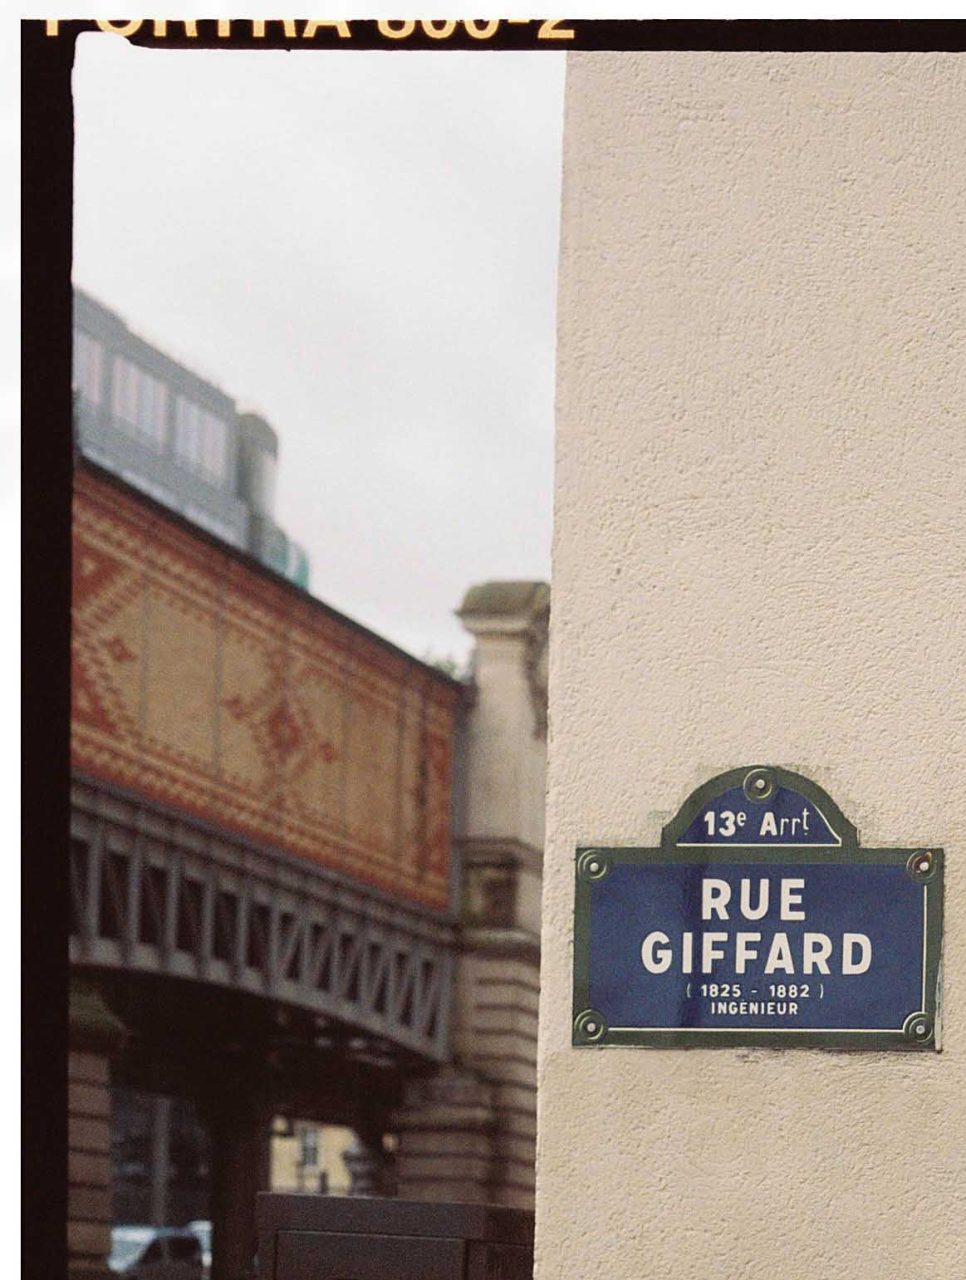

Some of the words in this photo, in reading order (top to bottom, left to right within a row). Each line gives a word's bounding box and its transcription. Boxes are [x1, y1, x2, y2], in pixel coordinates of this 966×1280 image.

[704, 810, 747, 837] 13e
[702, 879, 806, 921] RUE
[641, 931, 873, 975] GIFFARD
